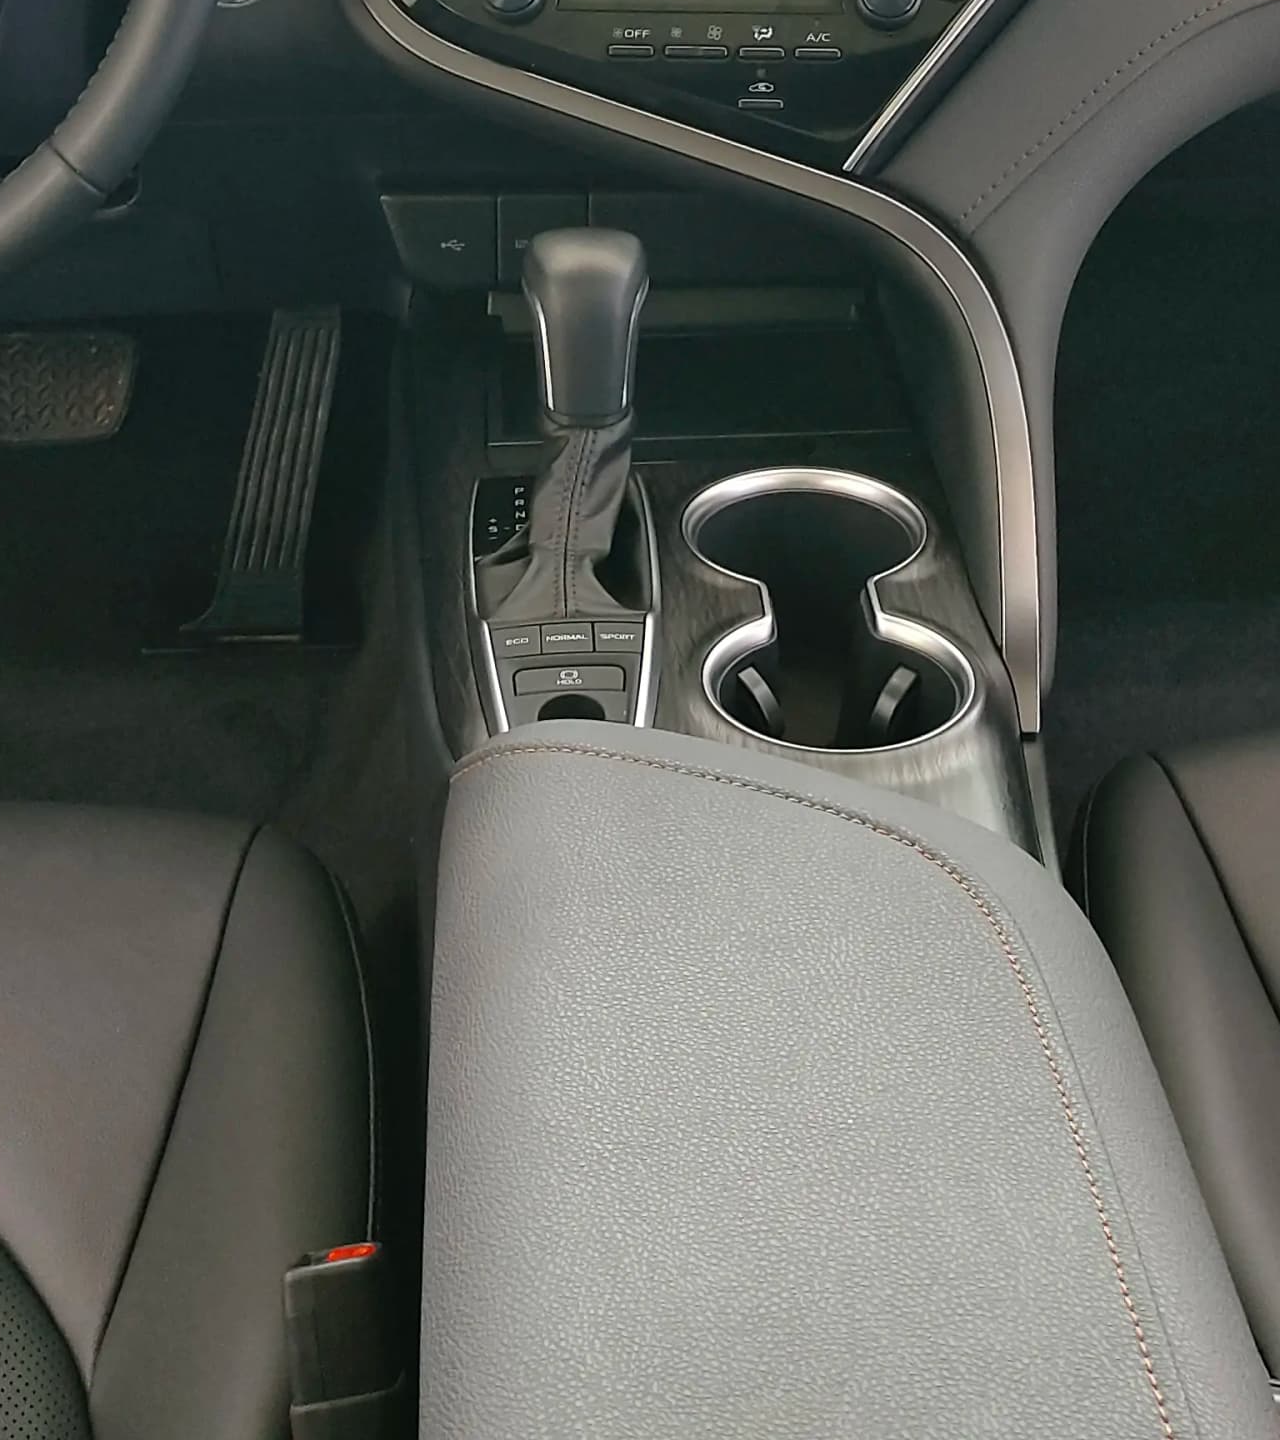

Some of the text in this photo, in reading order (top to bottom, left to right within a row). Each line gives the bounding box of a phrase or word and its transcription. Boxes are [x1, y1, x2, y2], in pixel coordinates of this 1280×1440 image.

[624, 29, 651, 39] OFF
[806, 32, 831, 43] A/C
[545, 633, 588, 643] NORMAL
[599, 632, 636, 641] SPORT
[505, 637, 529, 646] ECO
[556, 678, 582, 686] HOLD
